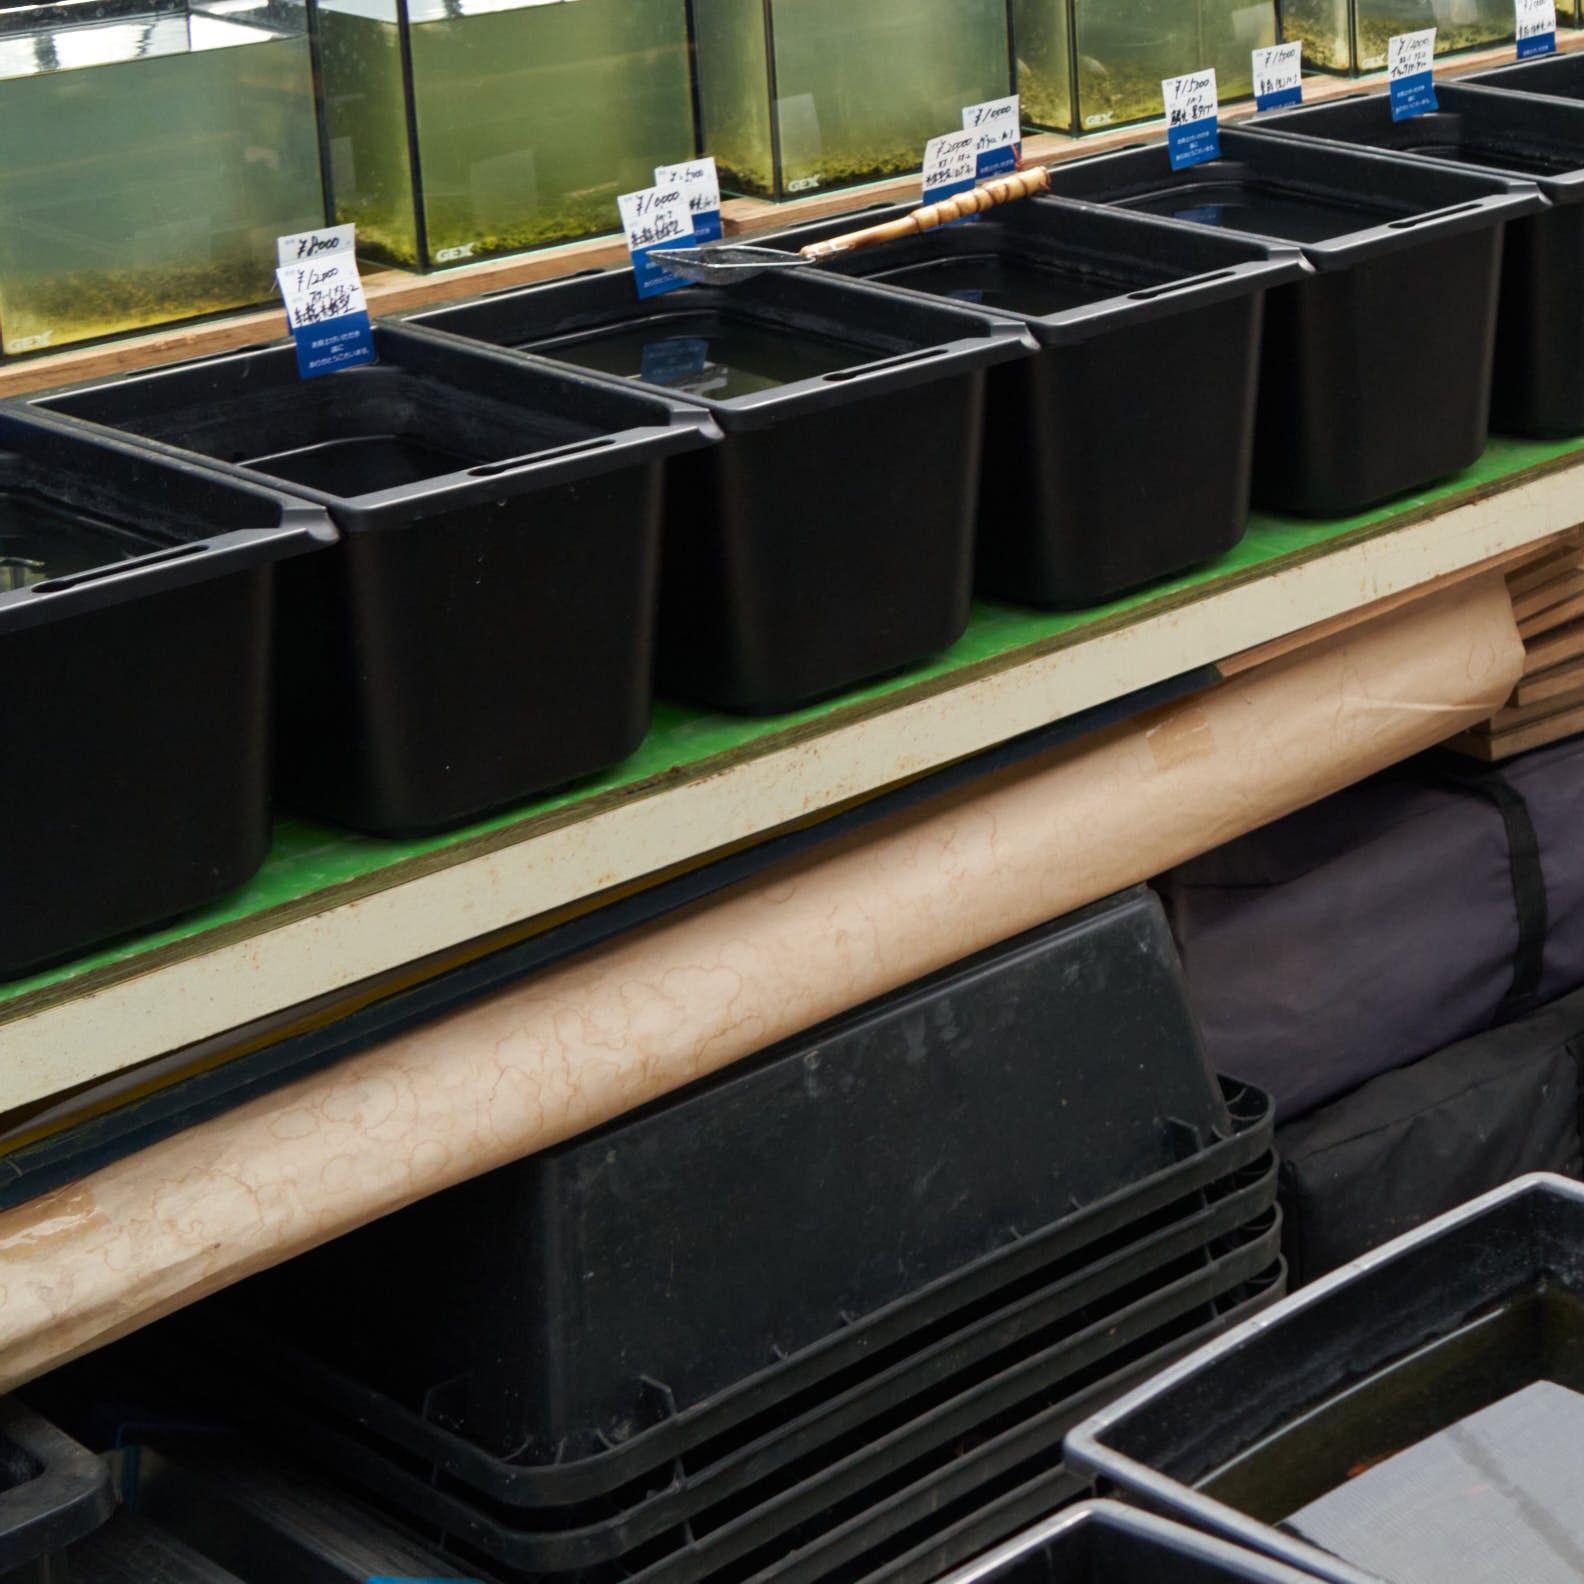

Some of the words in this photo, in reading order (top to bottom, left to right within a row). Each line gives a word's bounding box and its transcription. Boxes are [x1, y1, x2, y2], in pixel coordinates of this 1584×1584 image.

[787, 174, 821, 192] GEX
[435, 241, 474, 263] GEX
[7, 329, 54, 353] GEX
